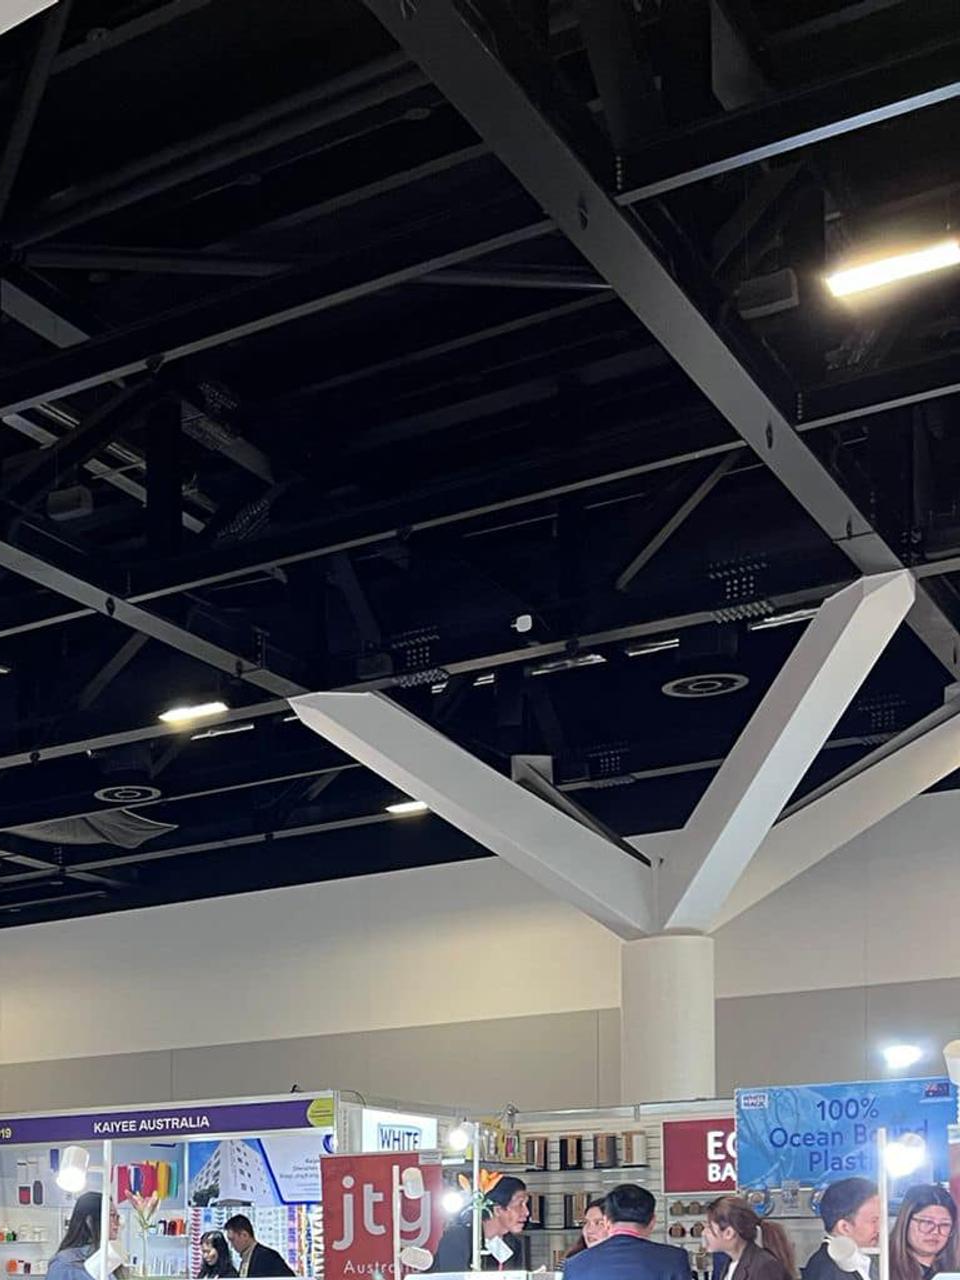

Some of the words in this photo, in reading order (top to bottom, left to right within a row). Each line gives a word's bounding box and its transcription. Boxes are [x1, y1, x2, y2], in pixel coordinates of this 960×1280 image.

[816, 1096, 879, 1121] 100%
[93, 1120, 137, 1133] KAIYEE
[139, 1116, 210, 1131] AUSTRALIA
[380, 1128, 419, 1150] WHITE
[769, 1127, 844, 1149] Ocean
[332, 1175, 431, 1250] jtg
